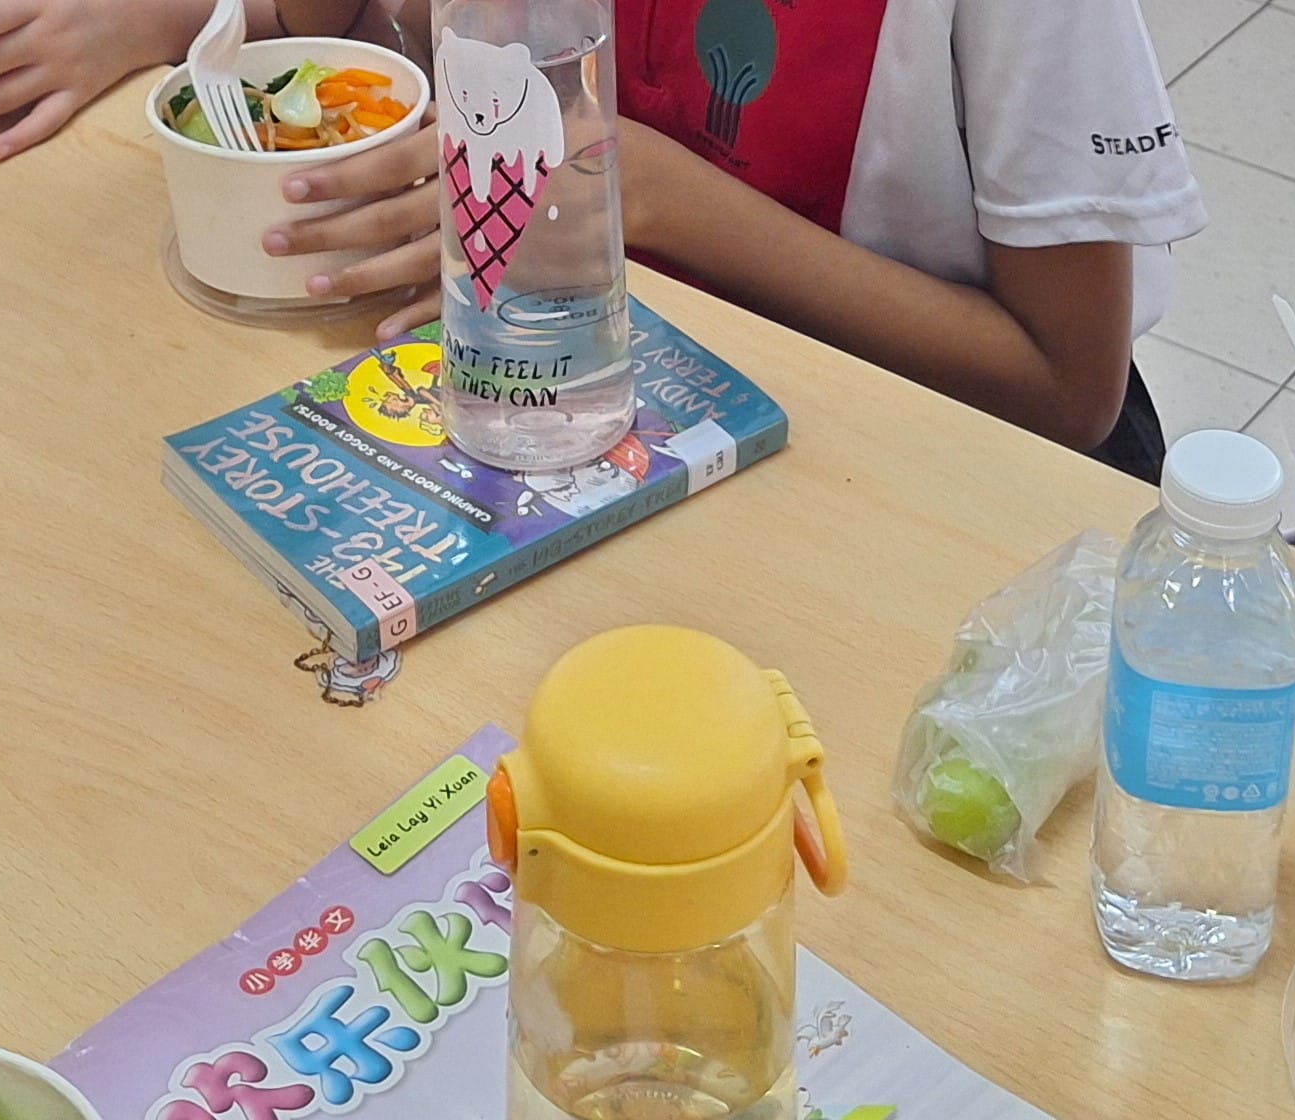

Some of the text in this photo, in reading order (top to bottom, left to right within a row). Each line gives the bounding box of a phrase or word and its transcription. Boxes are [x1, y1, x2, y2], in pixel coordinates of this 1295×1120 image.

[1091, 122, 1178, 155] STEADF
[491, 356, 542, 379] FEEL
[552, 355, 573, 377] IT
[642, 346, 731, 398] TERRY
[461, 370, 502, 402] THEY
[509, 387, 557, 407] CAN
[292, 404, 334, 432] BOOTS!
[335, 429, 378, 457] SOGGY
[376, 454, 403, 473] AND
[227, 410, 459, 564] TREEHOUSE
[439, 490, 492, 522] CAMPING
[366, 770, 479, 857] Leia Lay Yi Xuan
[242, 906, 354, 994] 小学华文
